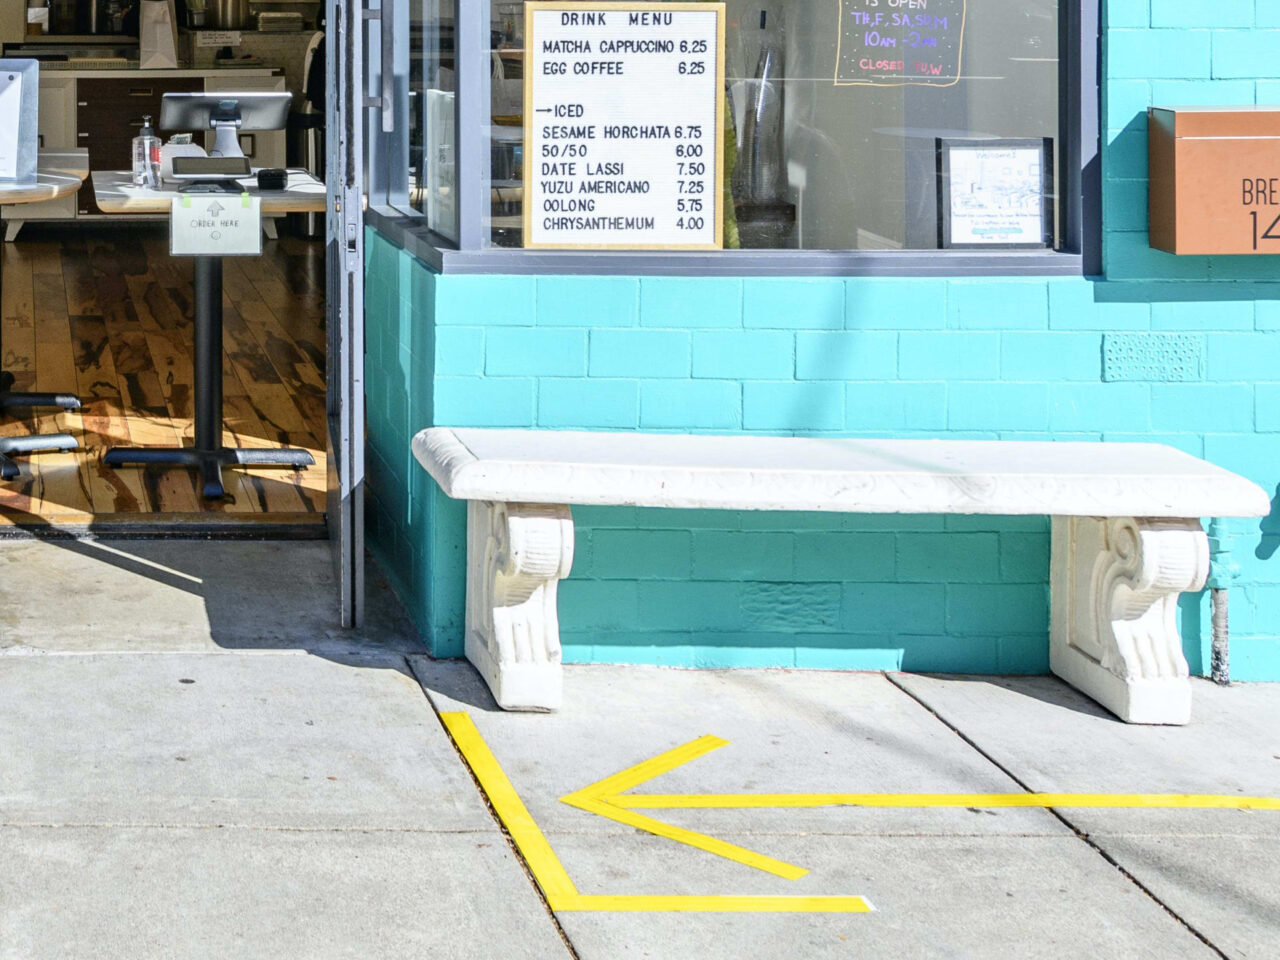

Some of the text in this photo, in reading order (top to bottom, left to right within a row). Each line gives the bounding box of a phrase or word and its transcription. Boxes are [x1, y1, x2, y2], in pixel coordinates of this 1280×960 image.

[561, 12, 673, 26] DRINK MENU
[543, 40, 707, 54] MATCHA CAPPUCCINO 6.25
[543, 62, 705, 75] EGG COFFEE 6.25
[859, 58, 904, 71] CLOSED
[554, 104, 584, 117] ICED
[542, 126, 702, 139] SESAME HORCHATA 6.75
[542, 144, 703, 157] 50/50 6.00
[542, 162, 705, 175] DATE LASSI 7.50
[541, 181, 704, 194] YUZU AMERICANO 7.25
[543, 199, 703, 212] OOLONG 5.75
[190, 219, 239, 228] ORDER HERE
[543, 217, 704, 230] CHRYSANTHEMUM 4.00
